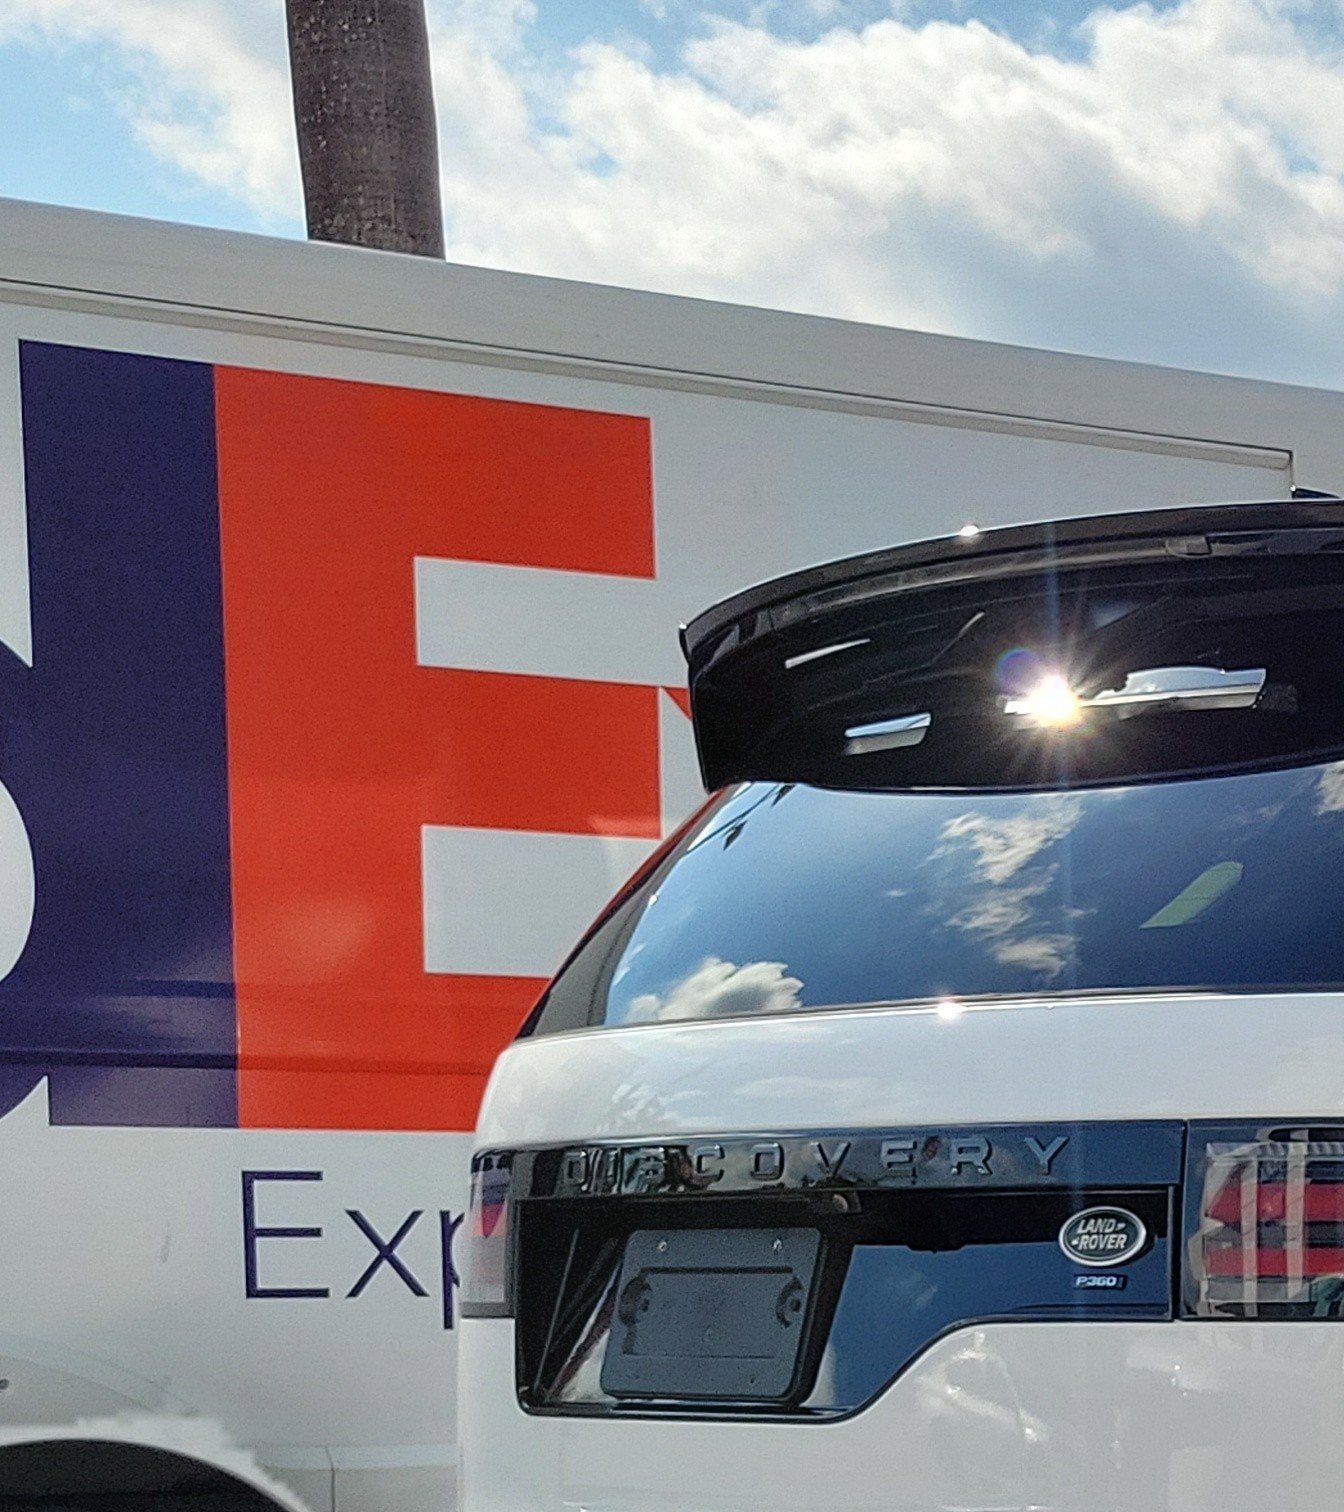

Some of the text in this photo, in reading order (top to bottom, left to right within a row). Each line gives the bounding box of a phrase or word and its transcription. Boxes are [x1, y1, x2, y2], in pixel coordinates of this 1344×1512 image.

[1076, 1218, 1117, 1234] LAND
[1077, 1233, 1128, 1250] ROVER
[1075, 1275, 1118, 1287] P360
